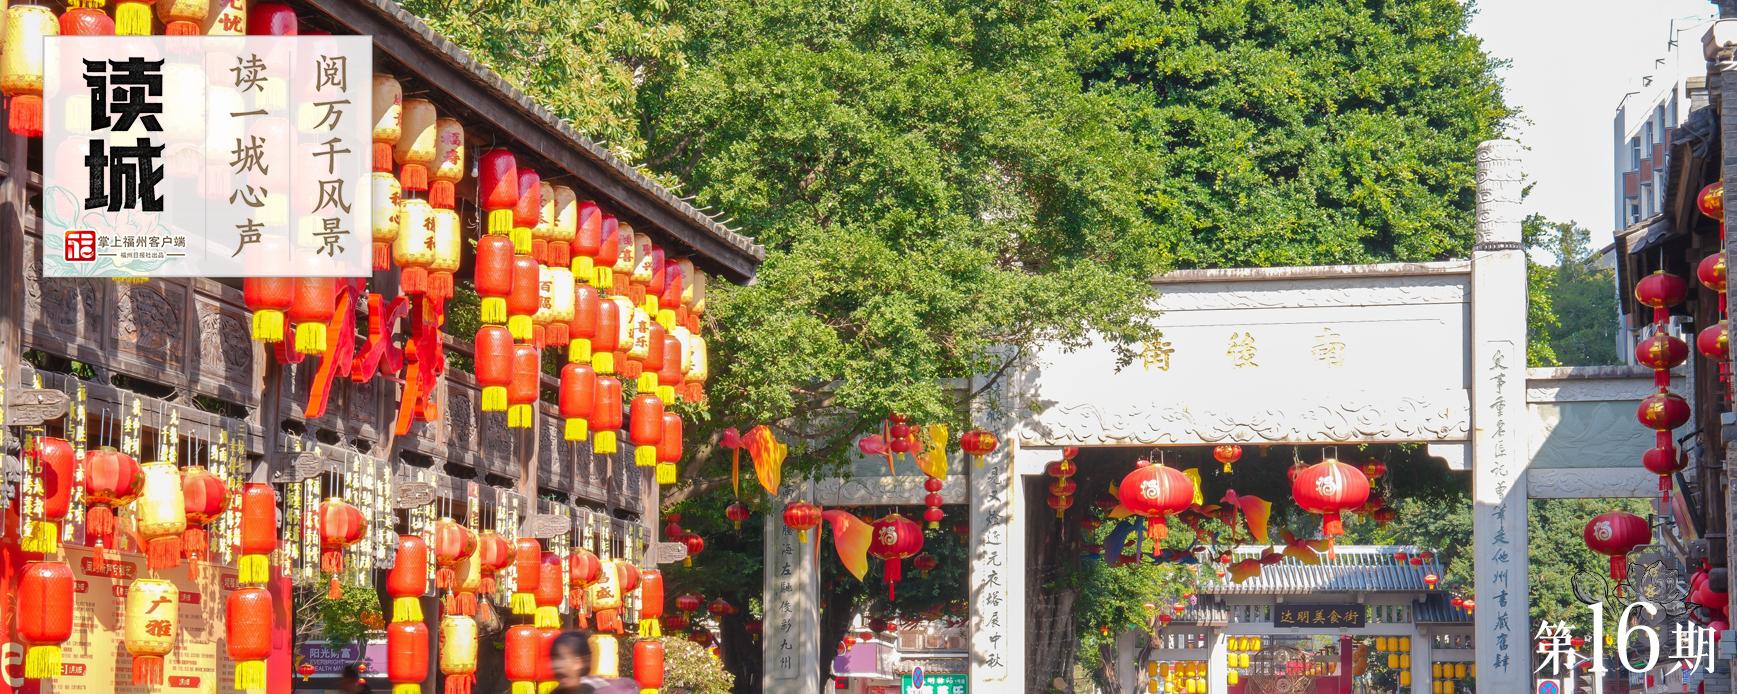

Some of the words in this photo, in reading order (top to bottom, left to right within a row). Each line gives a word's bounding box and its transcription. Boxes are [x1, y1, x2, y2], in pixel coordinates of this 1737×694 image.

[1280, 609, 1359, 625] 达明美食街
